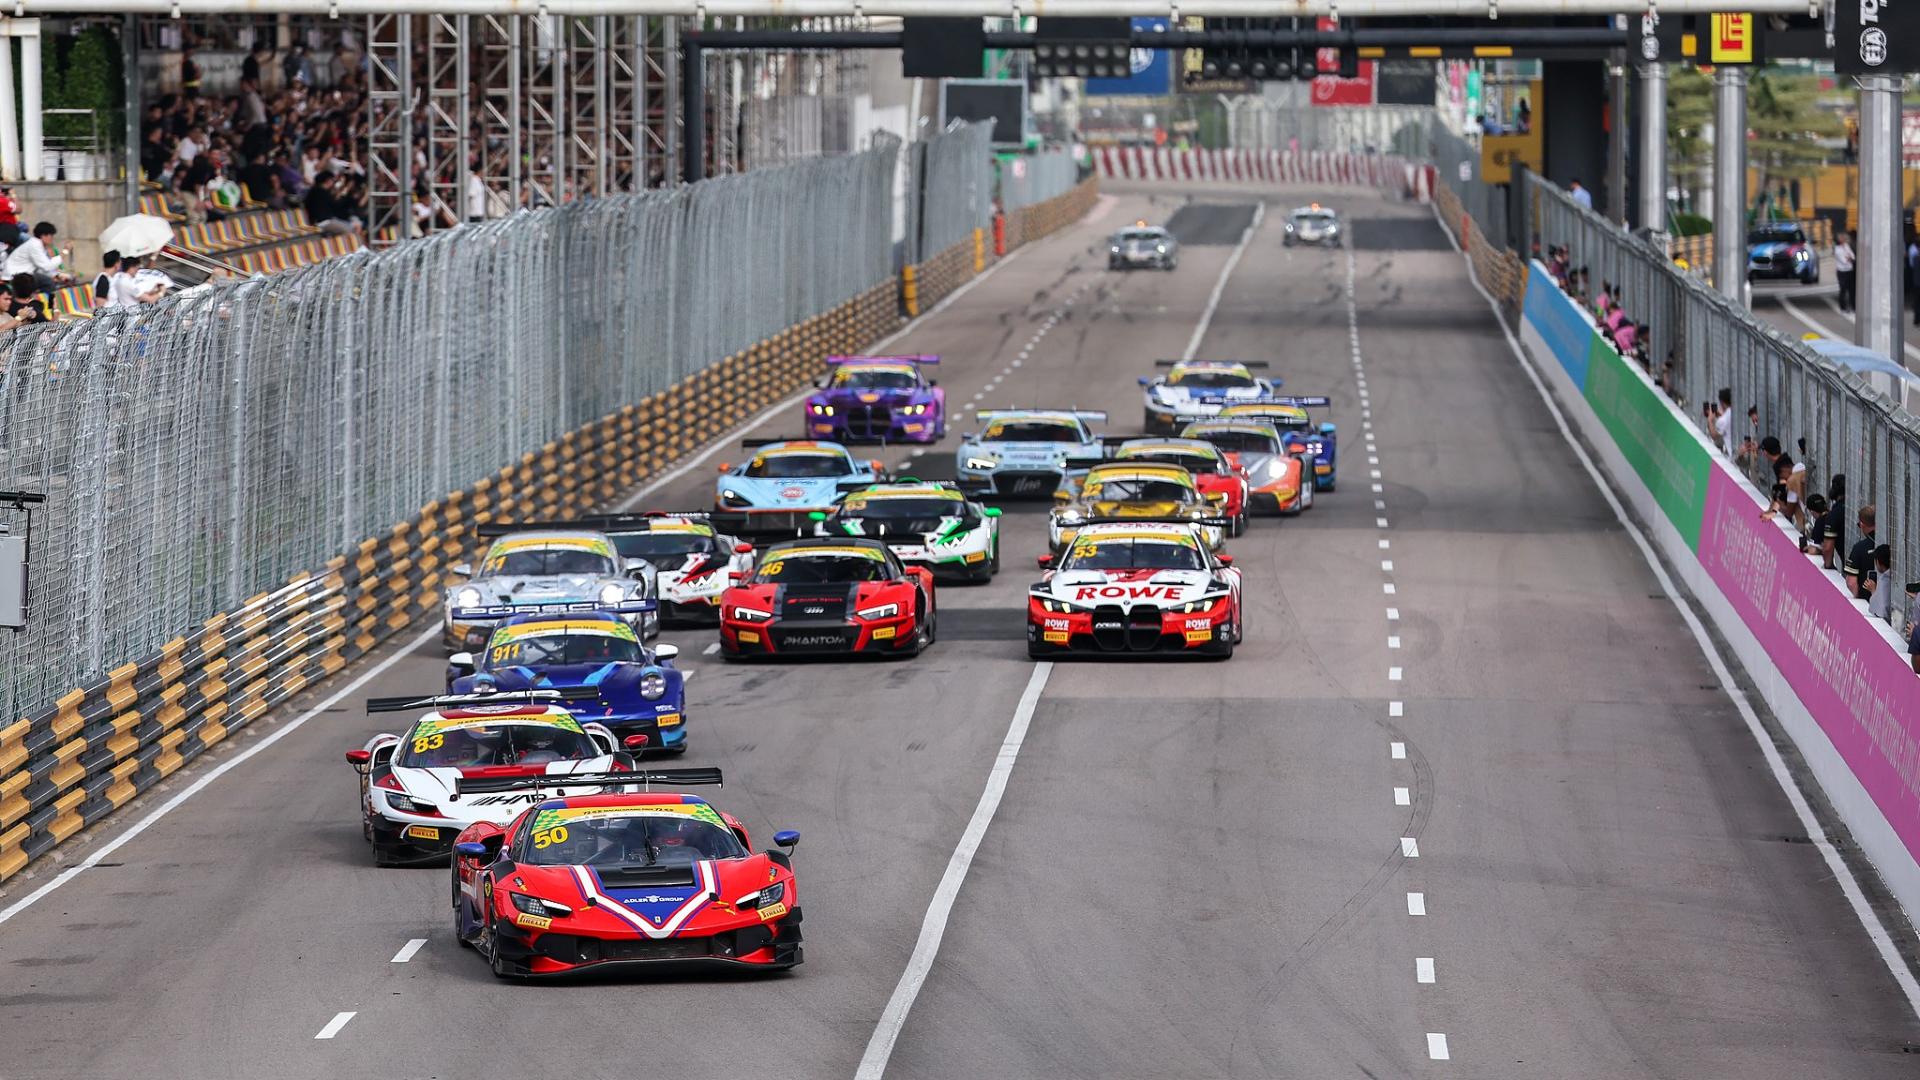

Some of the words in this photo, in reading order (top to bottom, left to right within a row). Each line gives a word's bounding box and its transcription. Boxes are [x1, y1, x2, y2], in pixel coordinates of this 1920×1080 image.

[1073, 545, 1098, 559] 53
[758, 561, 785, 577] 46
[1076, 586, 1185, 601] ROWE
[461, 600, 647, 615] PORSCHE
[1044, 618, 1070, 628] ROWE
[1185, 618, 1212, 629] ROWE
[784, 636, 847, 645] PHANTOM
[492, 643, 521, 663] 911
[413, 733, 445, 754] 83
[410, 827, 437, 838] PIRELLI
[534, 825, 570, 850] 50
[760, 905, 785, 918] PIRELLI
[520, 916, 548, 927] PIRELLI
